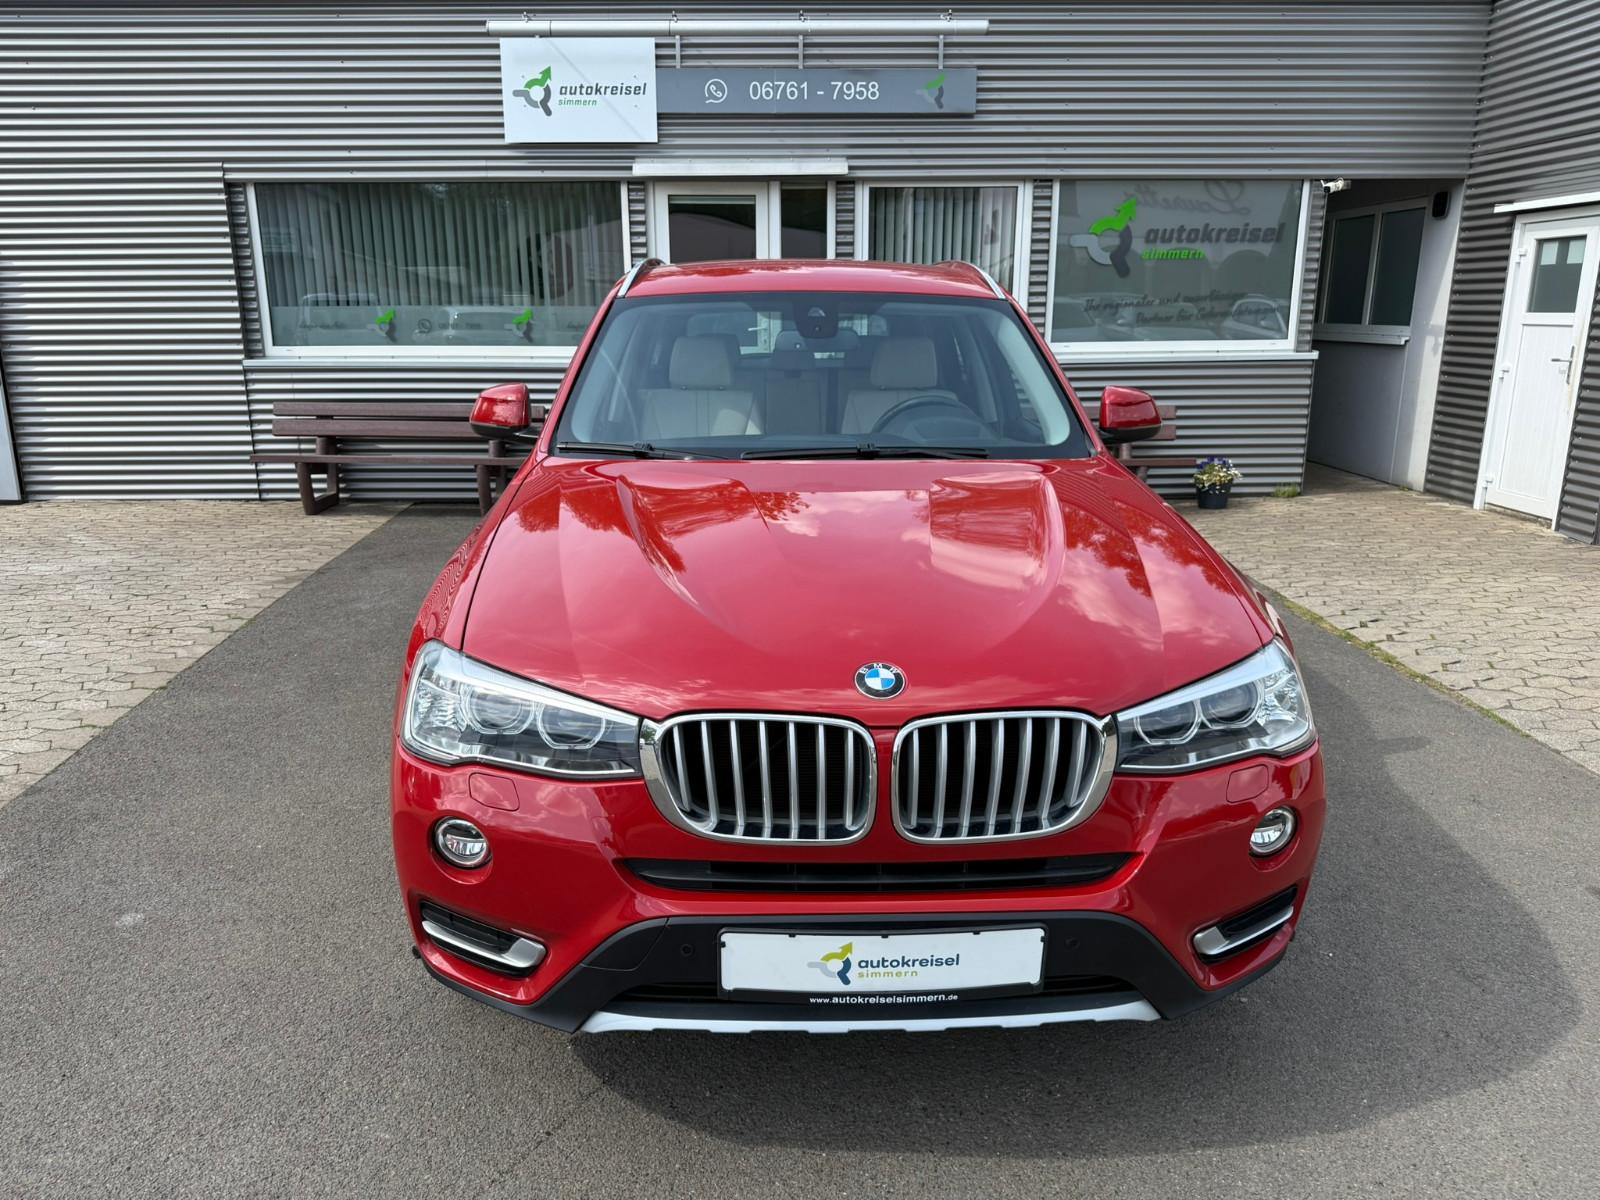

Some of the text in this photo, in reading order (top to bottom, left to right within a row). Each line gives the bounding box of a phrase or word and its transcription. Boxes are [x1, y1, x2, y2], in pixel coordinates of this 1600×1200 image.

[558, 81, 647, 98] autokreisel
[749, 81, 809, 101] 06761
[831, 81, 880, 101] 7958
[558, 98, 597, 107] simmern
[1144, 222, 1286, 244] autokreisel
[1141, 247, 1206, 260] simmern
[857, 953, 960, 969] autokreisel
[857, 970, 919, 979] simmern
[809, 993, 958, 1004] www.autokreiselsimmern.de
